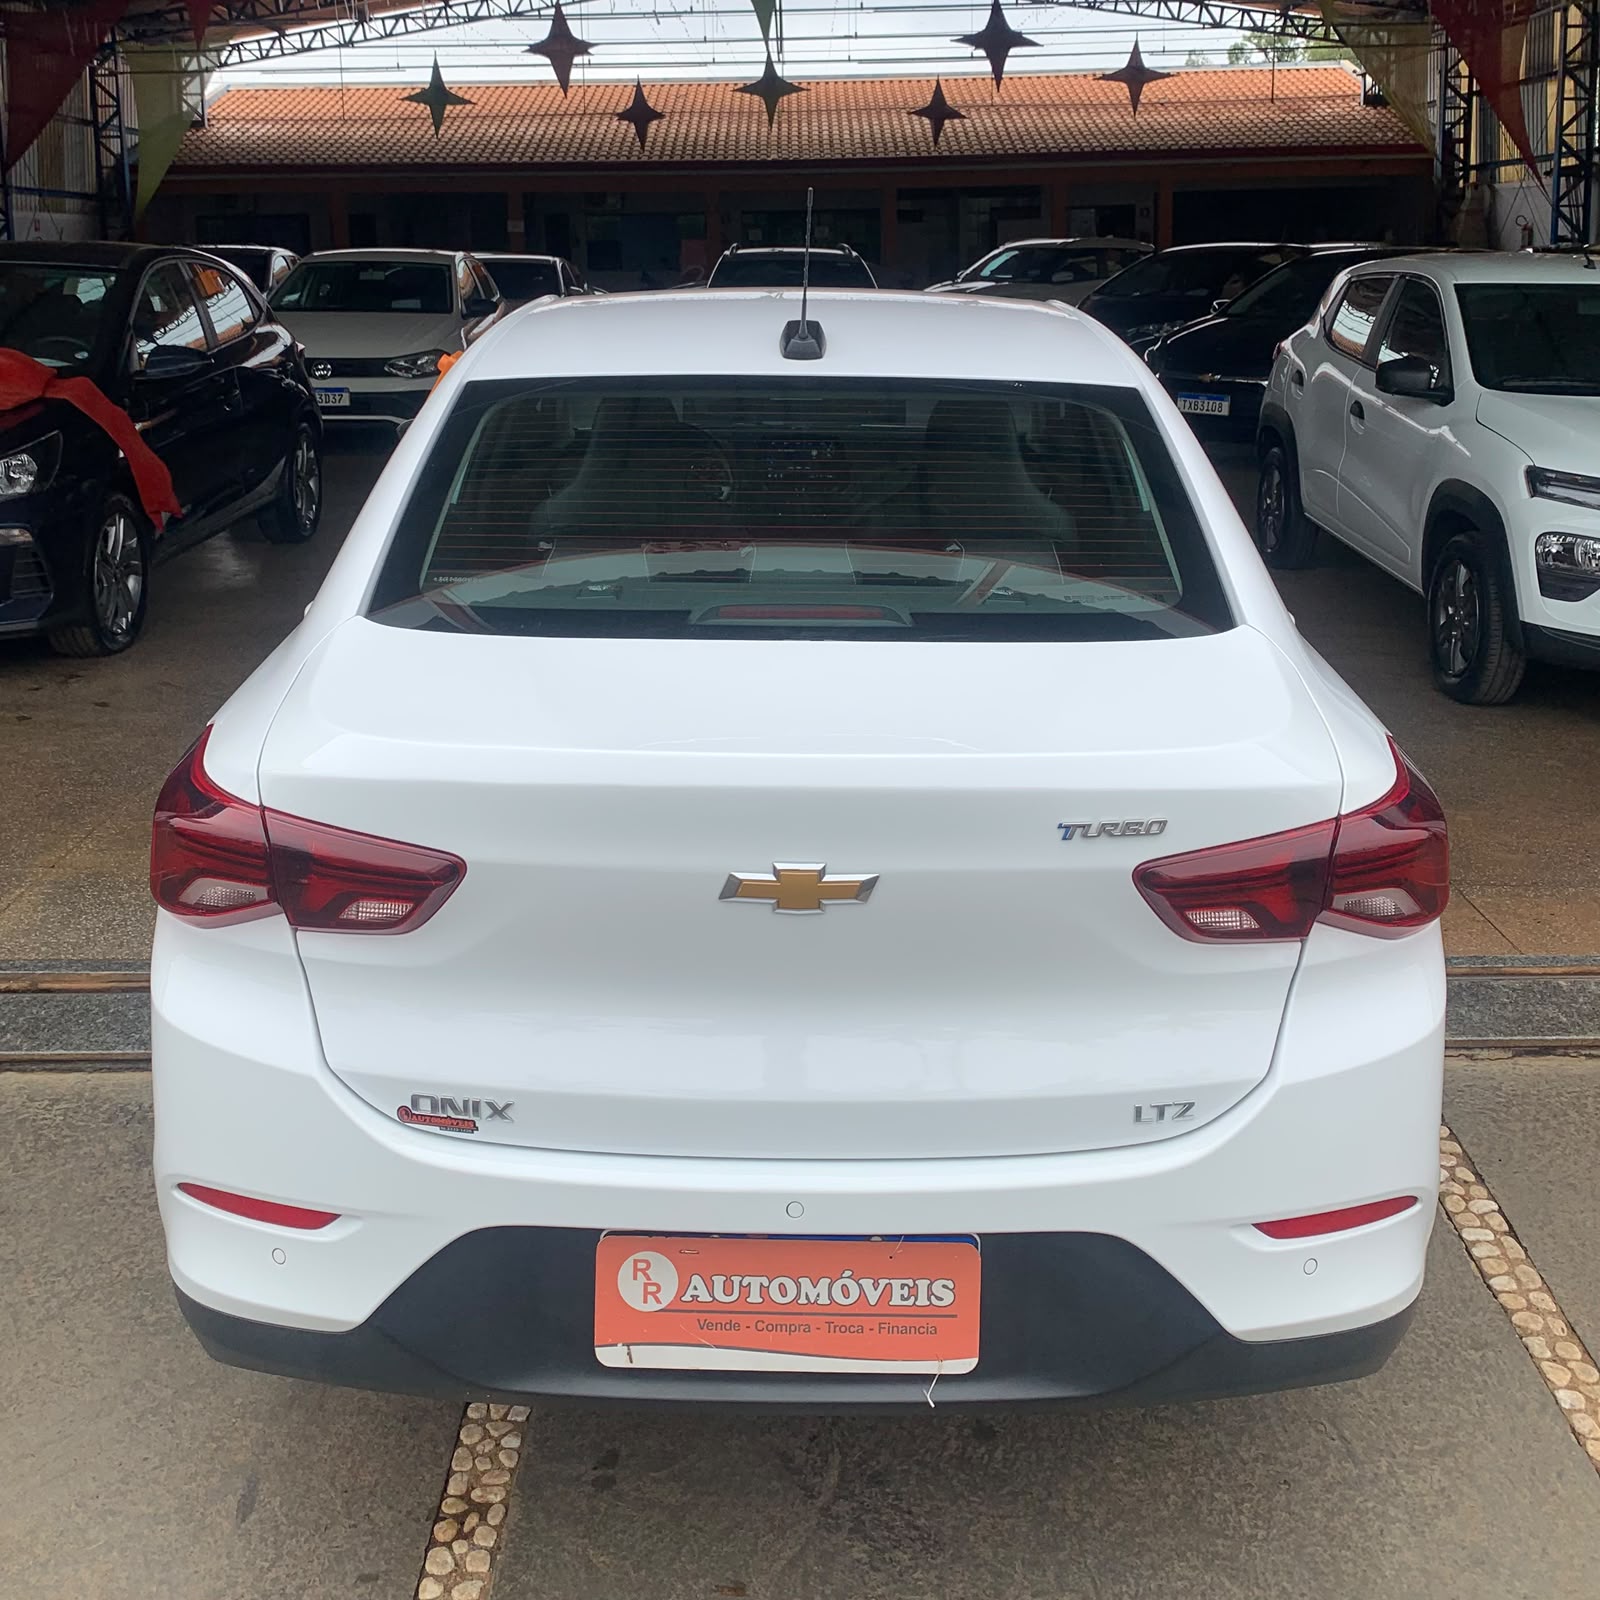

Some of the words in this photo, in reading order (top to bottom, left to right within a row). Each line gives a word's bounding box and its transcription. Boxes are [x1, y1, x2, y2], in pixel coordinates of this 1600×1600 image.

[1057, 819, 1168, 841] TURBO
[410, 1093, 514, 1122] ONIX
[1134, 1100, 1195, 1122] LTZ
[680, 1268, 956, 1307] AUTOMÓVEIS
[697, 1318, 742, 1332] Vende
[754, 1320, 812, 1335] Compra
[825, 1321, 864, 1335] Troca
[877, 1322, 938, 1336] Financia
